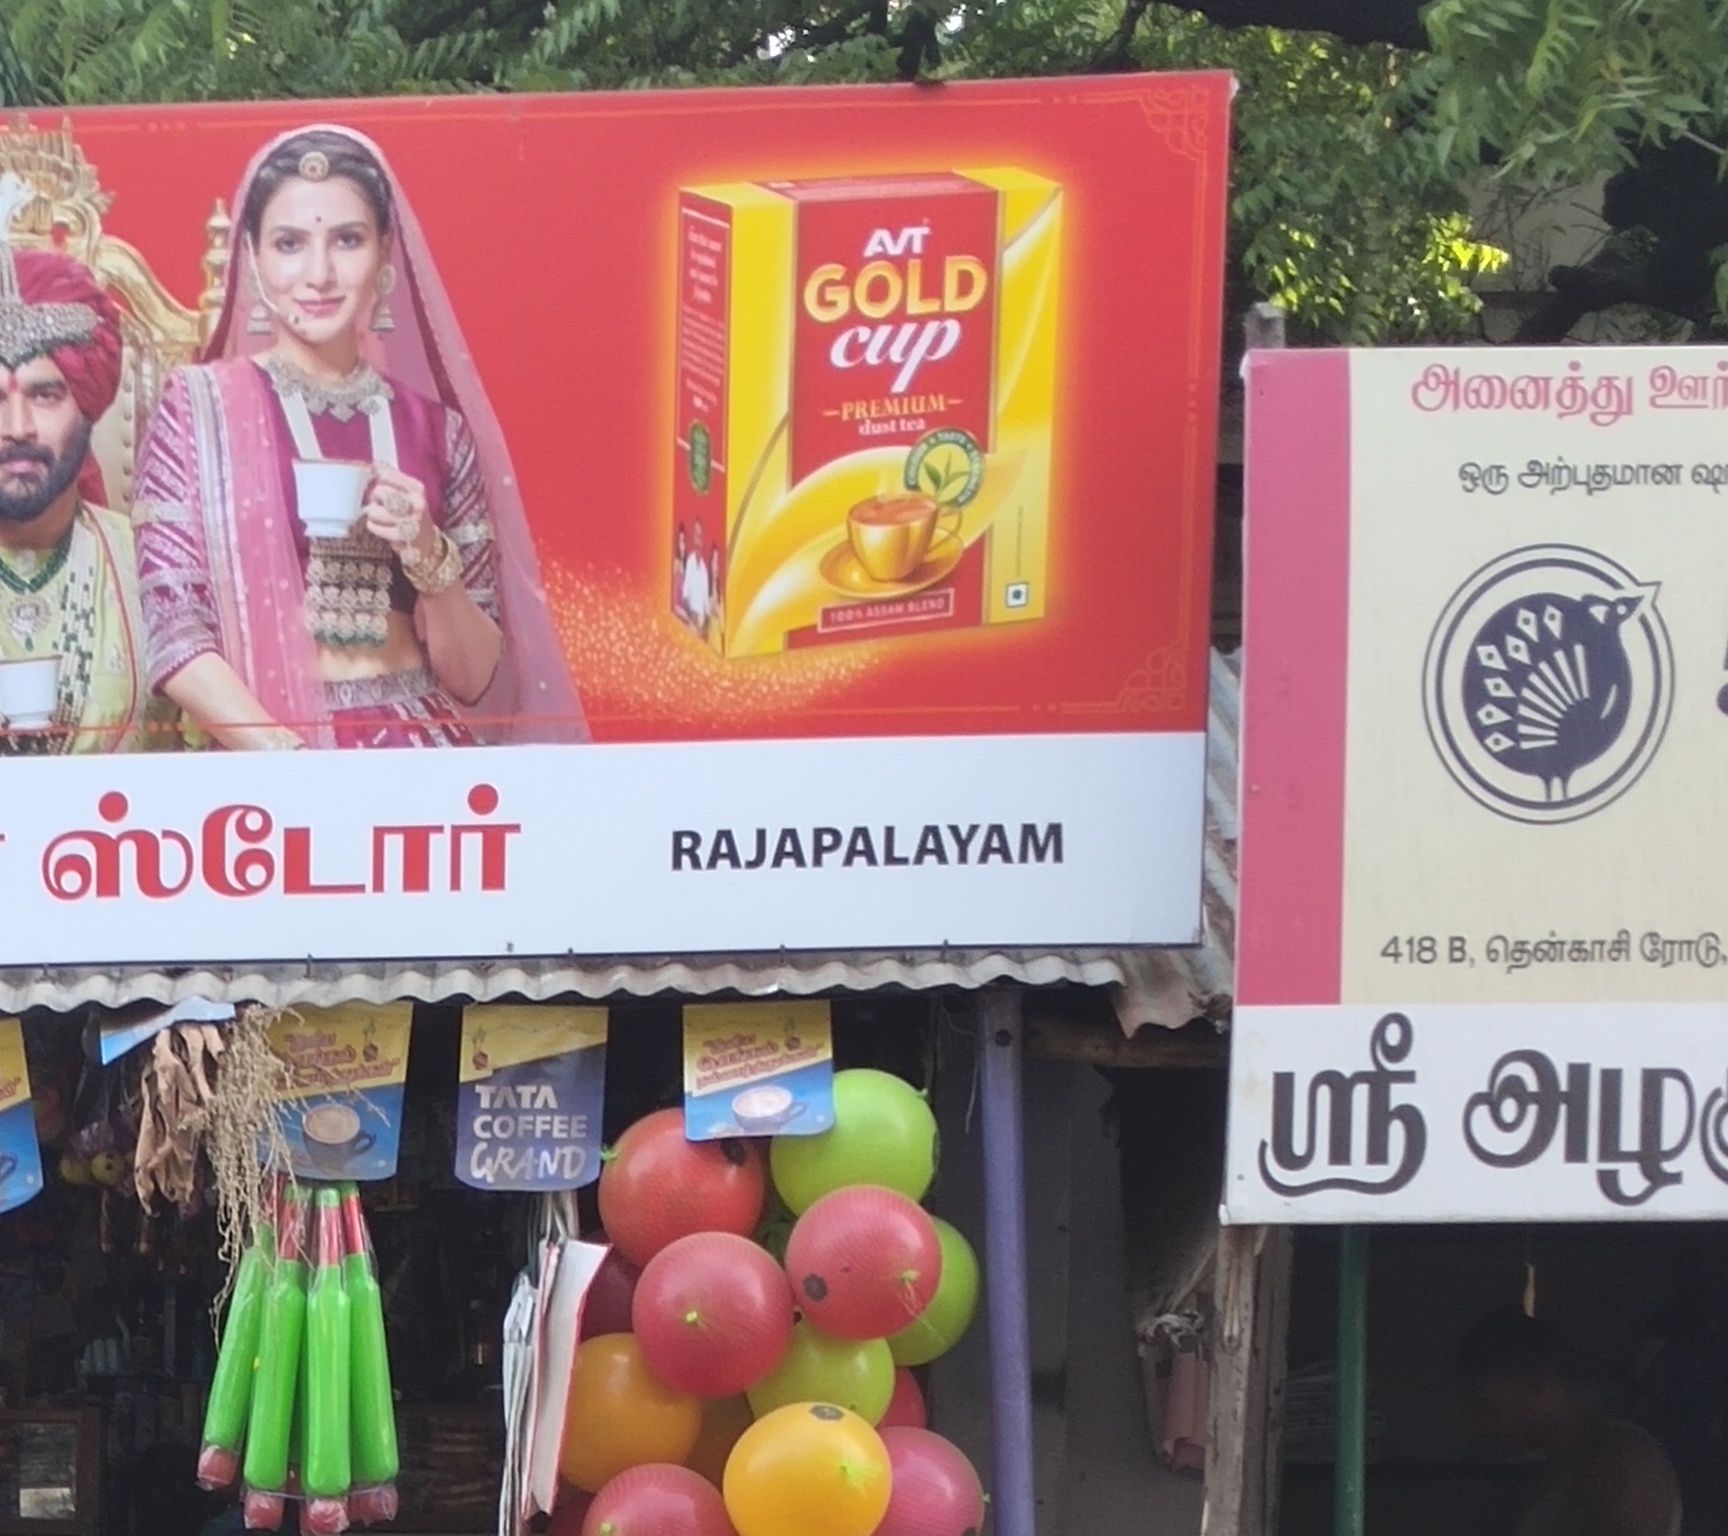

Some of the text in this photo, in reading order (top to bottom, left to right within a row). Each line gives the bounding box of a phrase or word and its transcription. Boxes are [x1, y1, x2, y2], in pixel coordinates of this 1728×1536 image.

[862, 226, 932, 258] AVT
[803, 255, 989, 324] GOLD
[828, 316, 962, 394] cup
[840, 394, 946, 421] PREMIUM
[1410, 360, 1635, 427] அனைத்து
[858, 417, 927, 437] dust tea
[1458, 461, 1509, 495] ஒரு
[1516, 456, 1684, 496] அற்புதமான
[866, 602, 905, 618] ASSAM
[906, 596, 946, 612] BLEND
[41, 782, 522, 901] ஸ்டோர்
[671, 822, 1065, 872] RAJAPALAYAM
[1379, 935, 1439, 965] 418
[1447, 936, 1476, 968] B,
[1485, 929, 1632, 974] தென்காசி
[474, 1084, 559, 1110] TATA
[473, 1114, 589, 1140] COFFEE
[470, 1141, 587, 1184] GRAND
